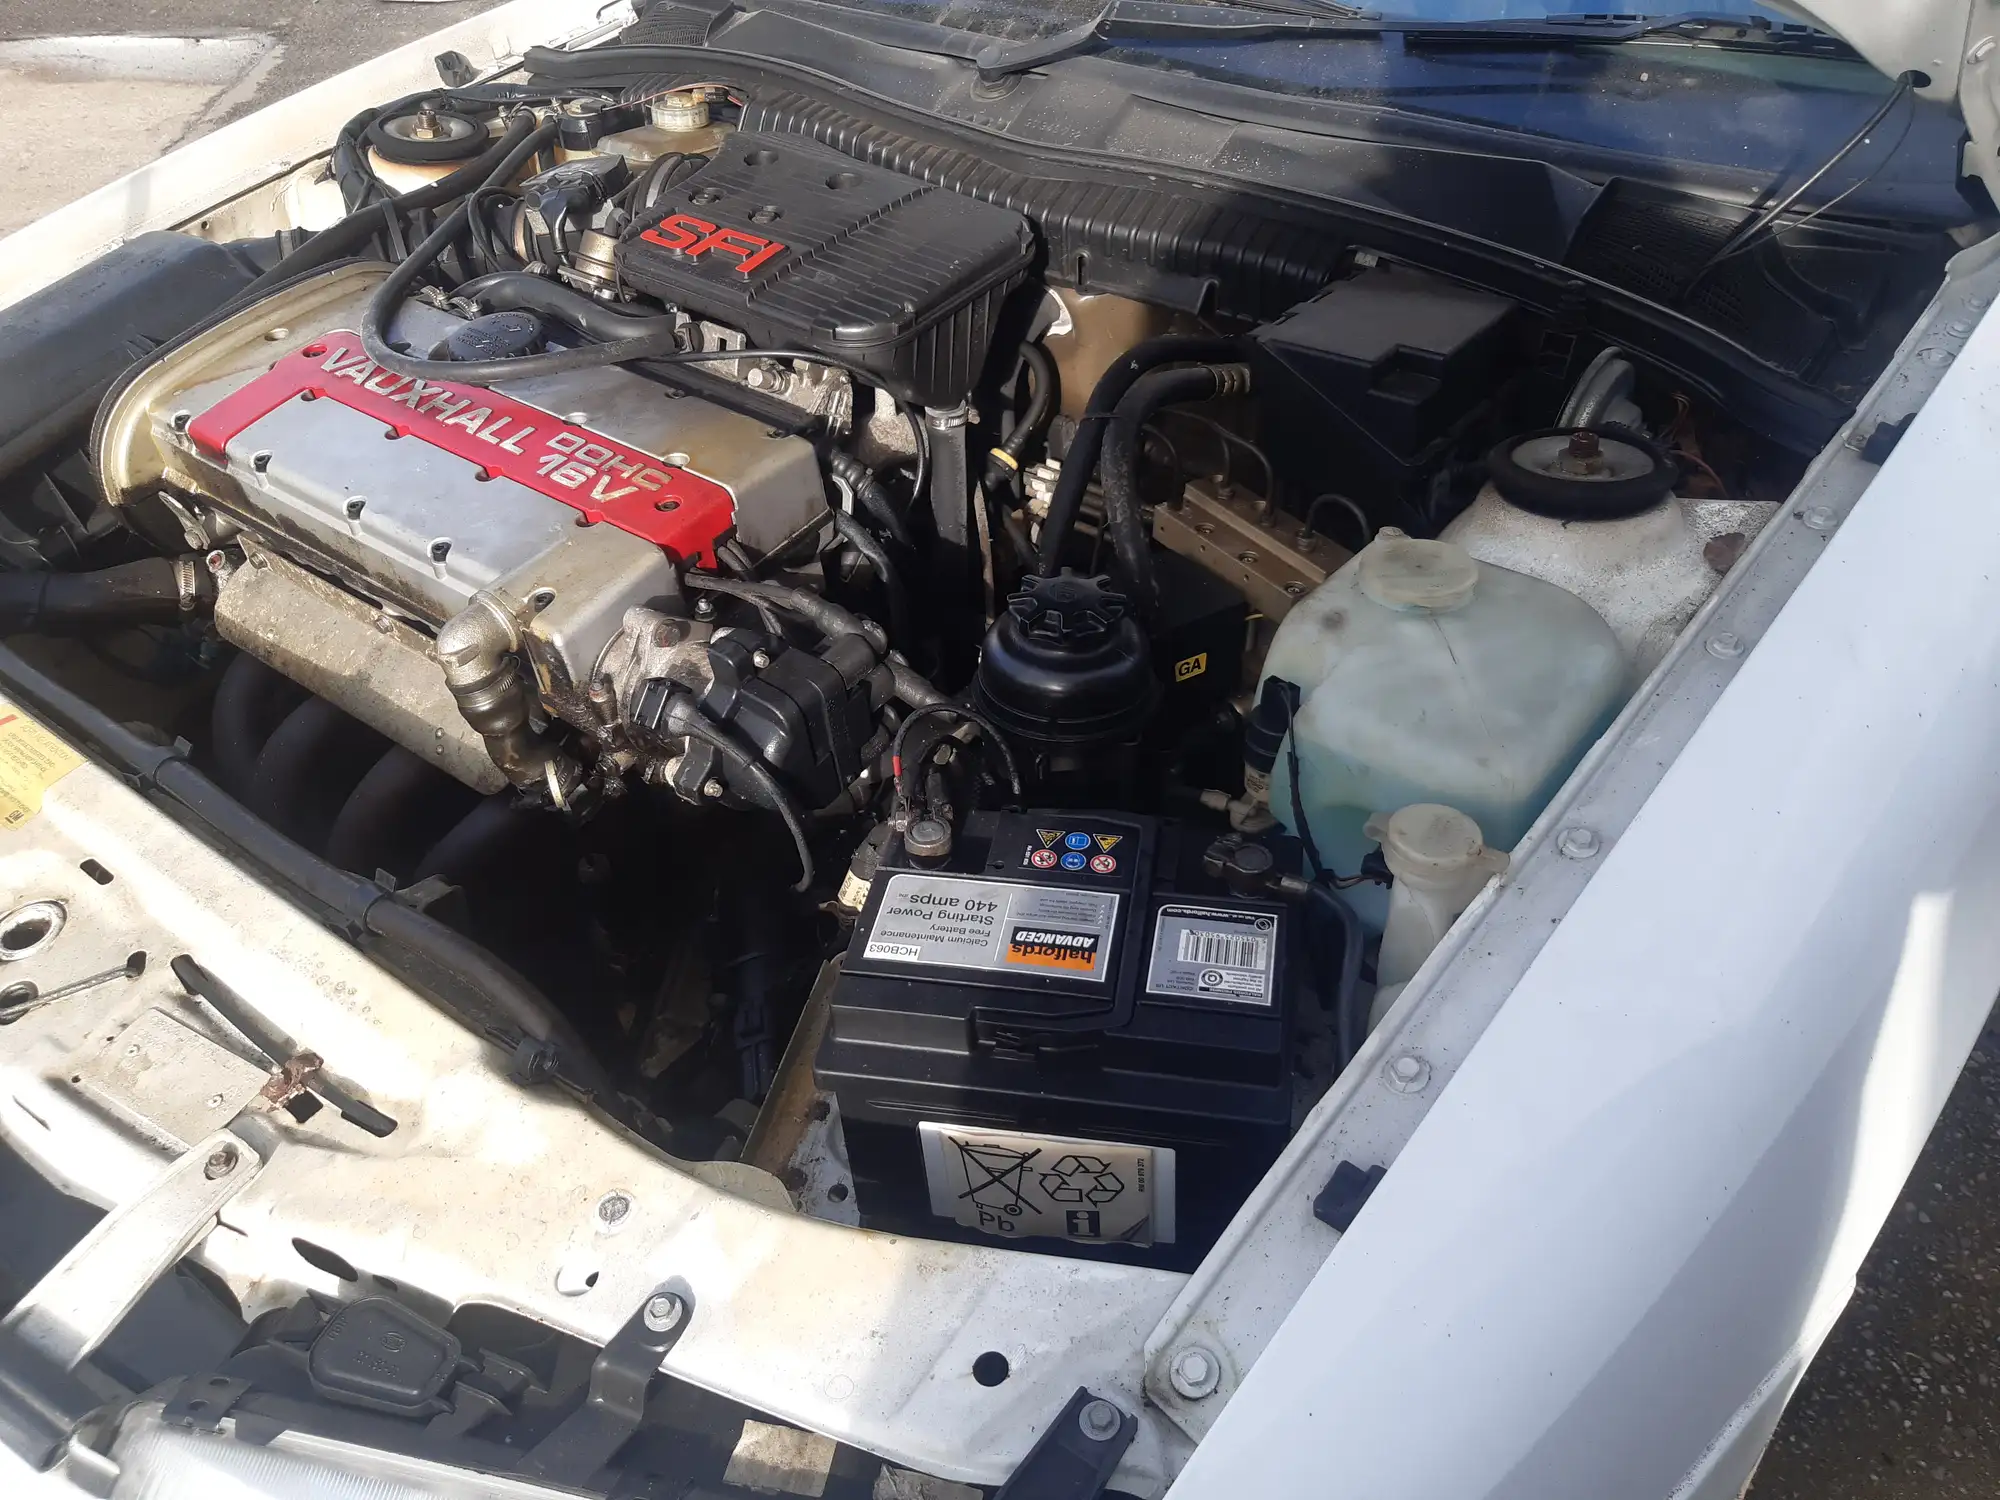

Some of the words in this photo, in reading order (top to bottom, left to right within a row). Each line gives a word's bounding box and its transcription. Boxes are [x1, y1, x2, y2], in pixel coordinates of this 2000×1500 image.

[640, 213, 785, 273] SFI
[320, 347, 535, 455] VAUXHALL
[546, 431, 674, 491] DOHC
[537, 453, 639, 503] 16V
[1179, 658, 1201, 676] GA
[909, 893, 960, 907] amps
[964, 899, 998, 913] 440
[886, 906, 933, 920] Power
[937, 909, 995, 926] Starting
[881, 929, 945, 943] Maintenance
[930, 923, 967, 936] Battery
[968, 928, 991, 937] Free
[947, 935, 988, 947] Calcium
[1015, 931, 1095, 948] ADVANCED
[869, 943, 918, 956] HCB063
[1012, 943, 1092, 964] halfords
[979, 1212, 1015, 1232] Pb
